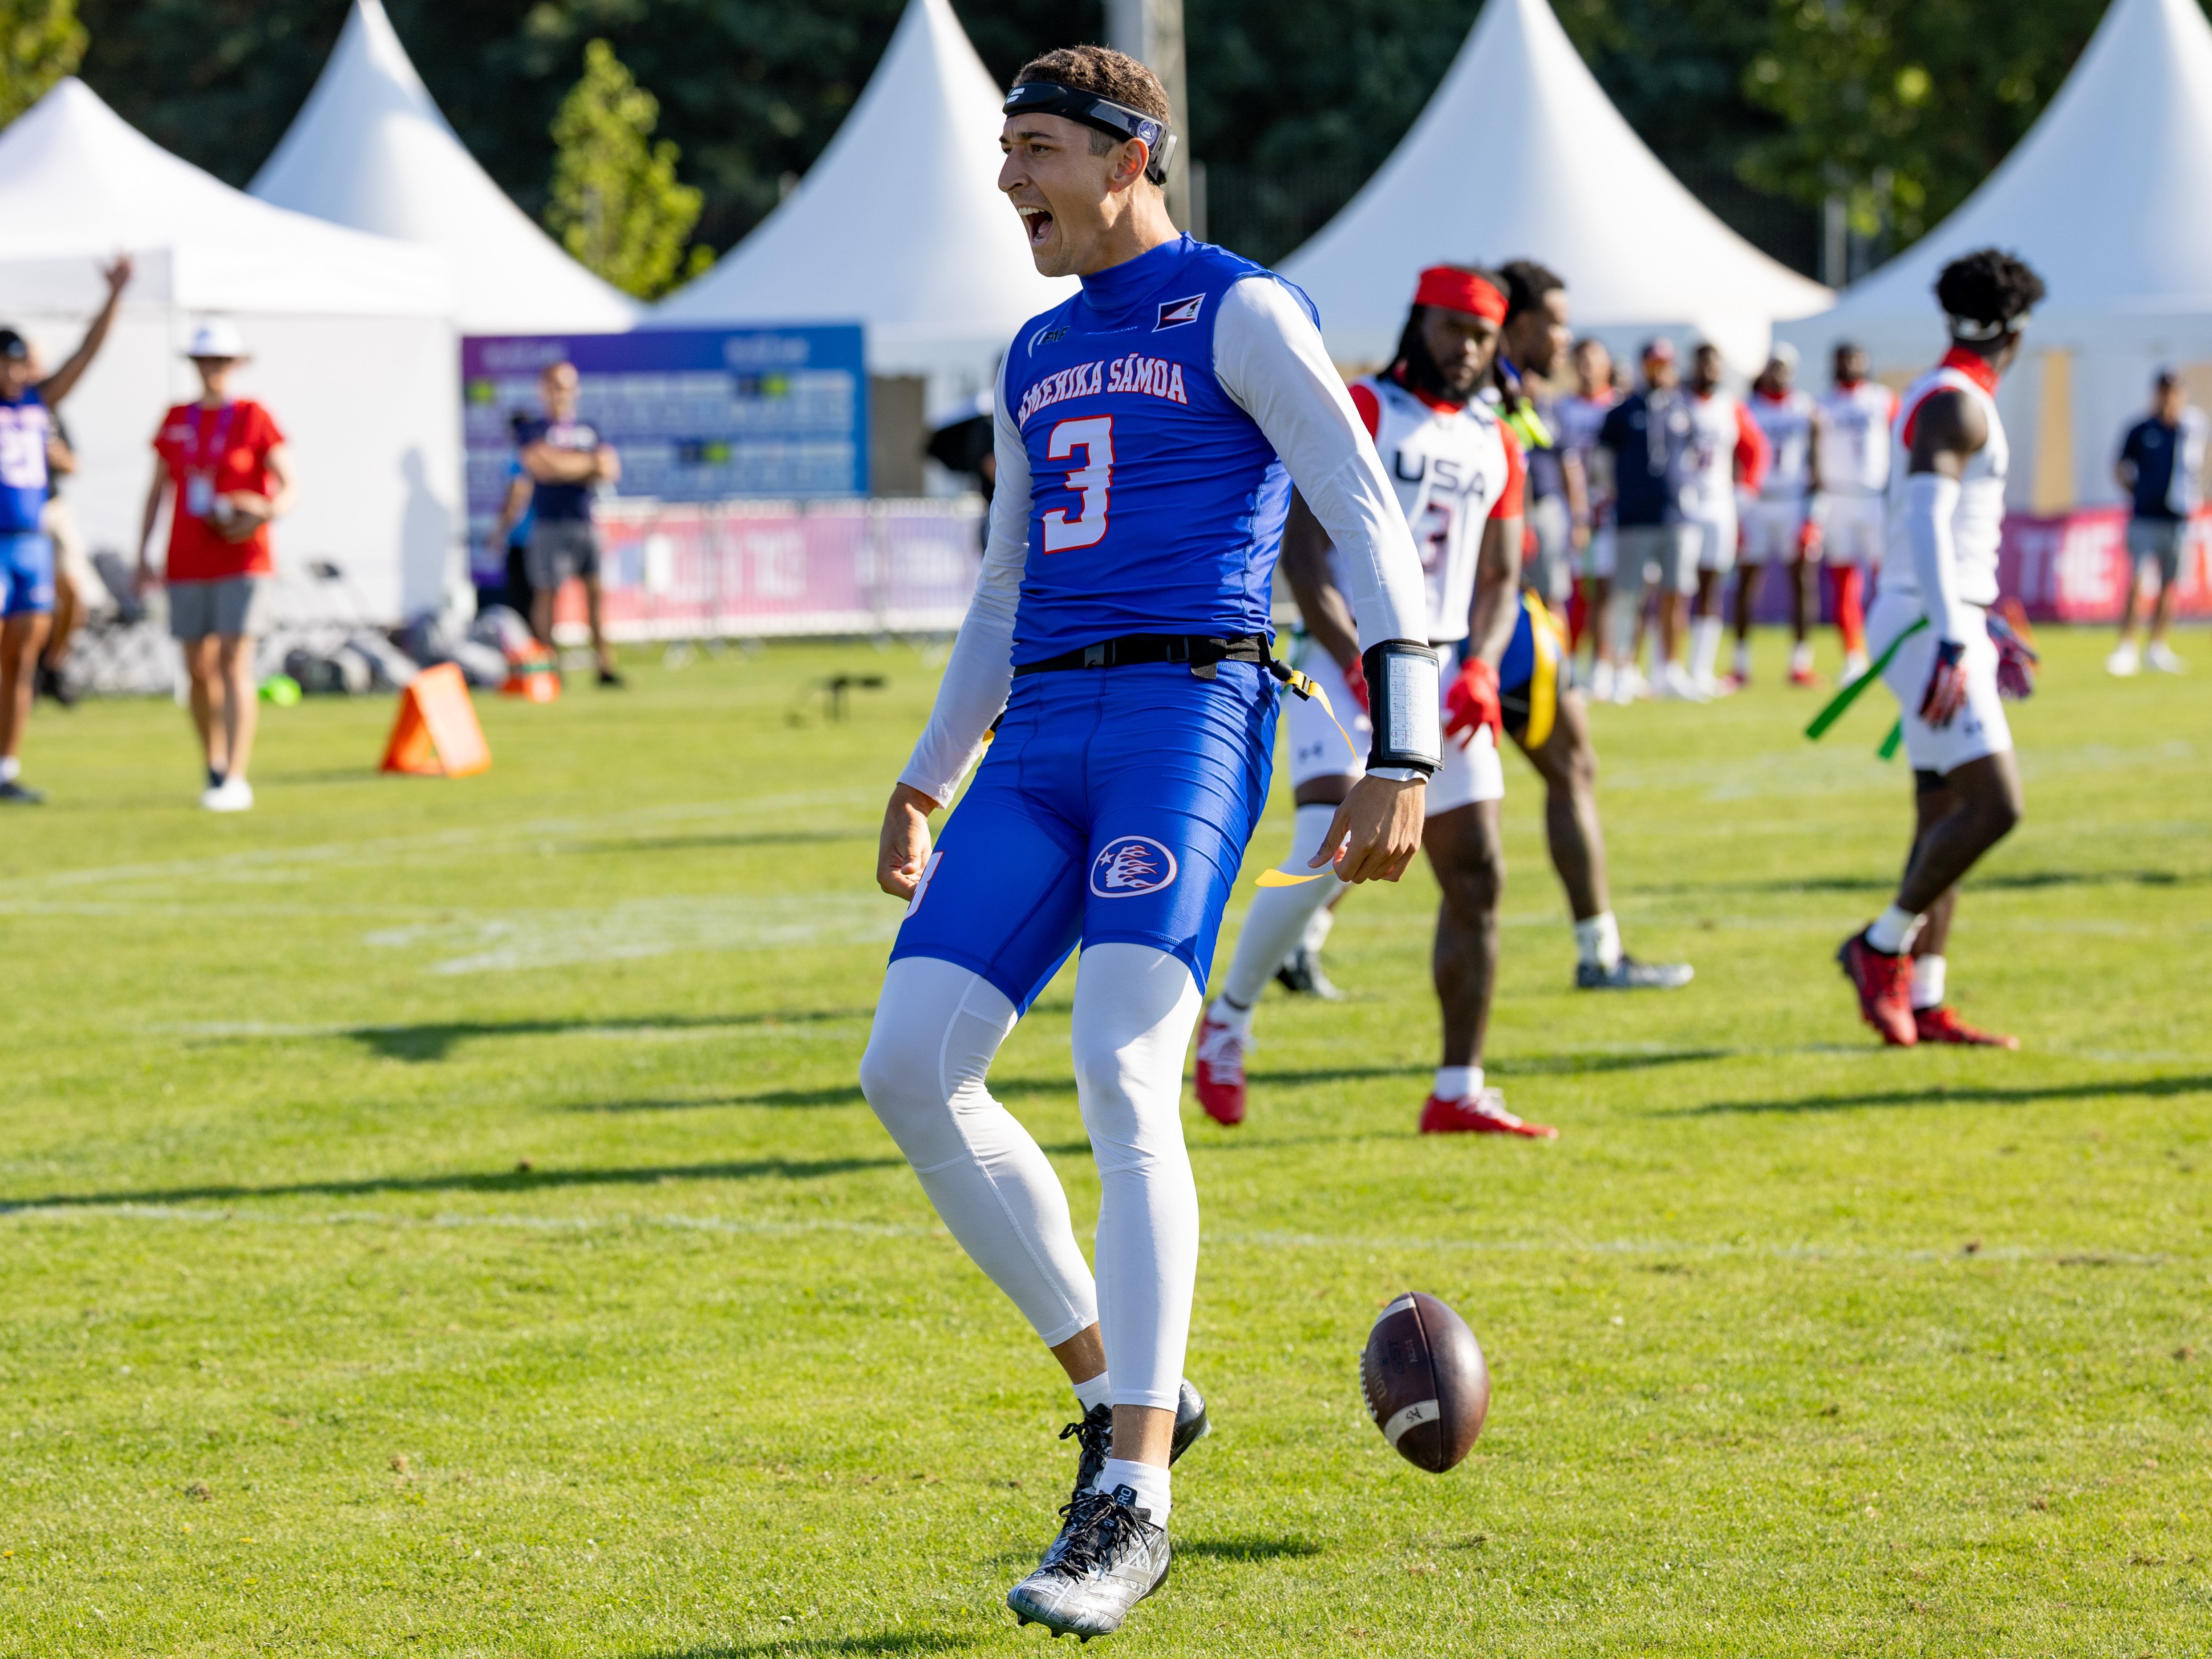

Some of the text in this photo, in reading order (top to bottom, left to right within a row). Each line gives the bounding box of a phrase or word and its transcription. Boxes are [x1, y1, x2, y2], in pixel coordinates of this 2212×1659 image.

[1037, 325, 1071, 345] IFAF
[1041, 414, 1115, 555] 3
[1394, 450, 1485, 501] USA
